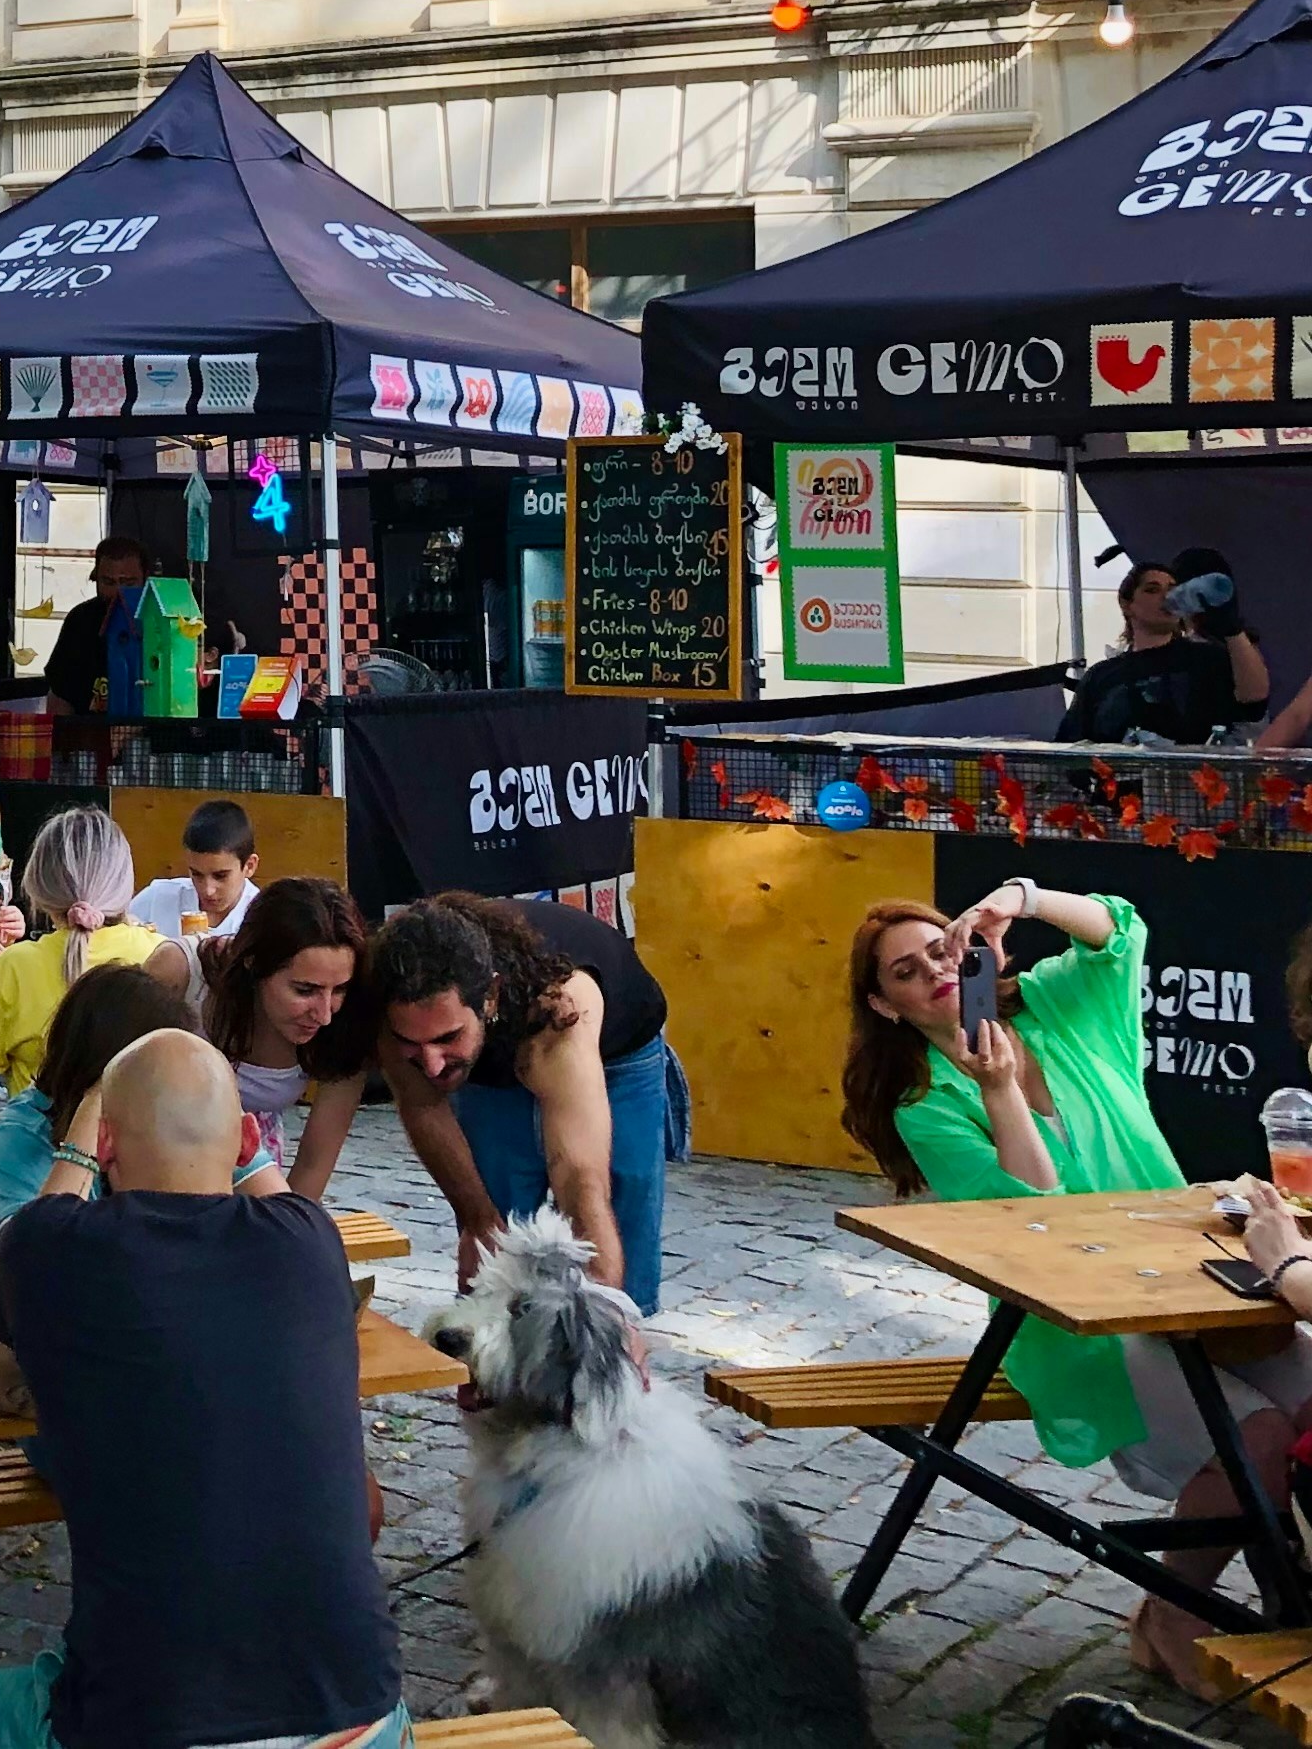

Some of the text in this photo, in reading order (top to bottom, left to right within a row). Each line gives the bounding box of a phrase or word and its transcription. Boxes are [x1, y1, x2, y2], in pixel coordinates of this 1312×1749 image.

[1138, 104, 1312, 174] გემ
[387, 271, 496, 307] GEMO
[876, 336, 1064, 396] GEMO
[250, 471, 292, 534] 4
[592, 588, 636, 611] Fries
[589, 615, 726, 643] Chicken Wings 20
[592, 641, 644, 666] Oyster
[588, 662, 718, 687] Chicken Box 15
[824, 804, 864, 817] 40%
